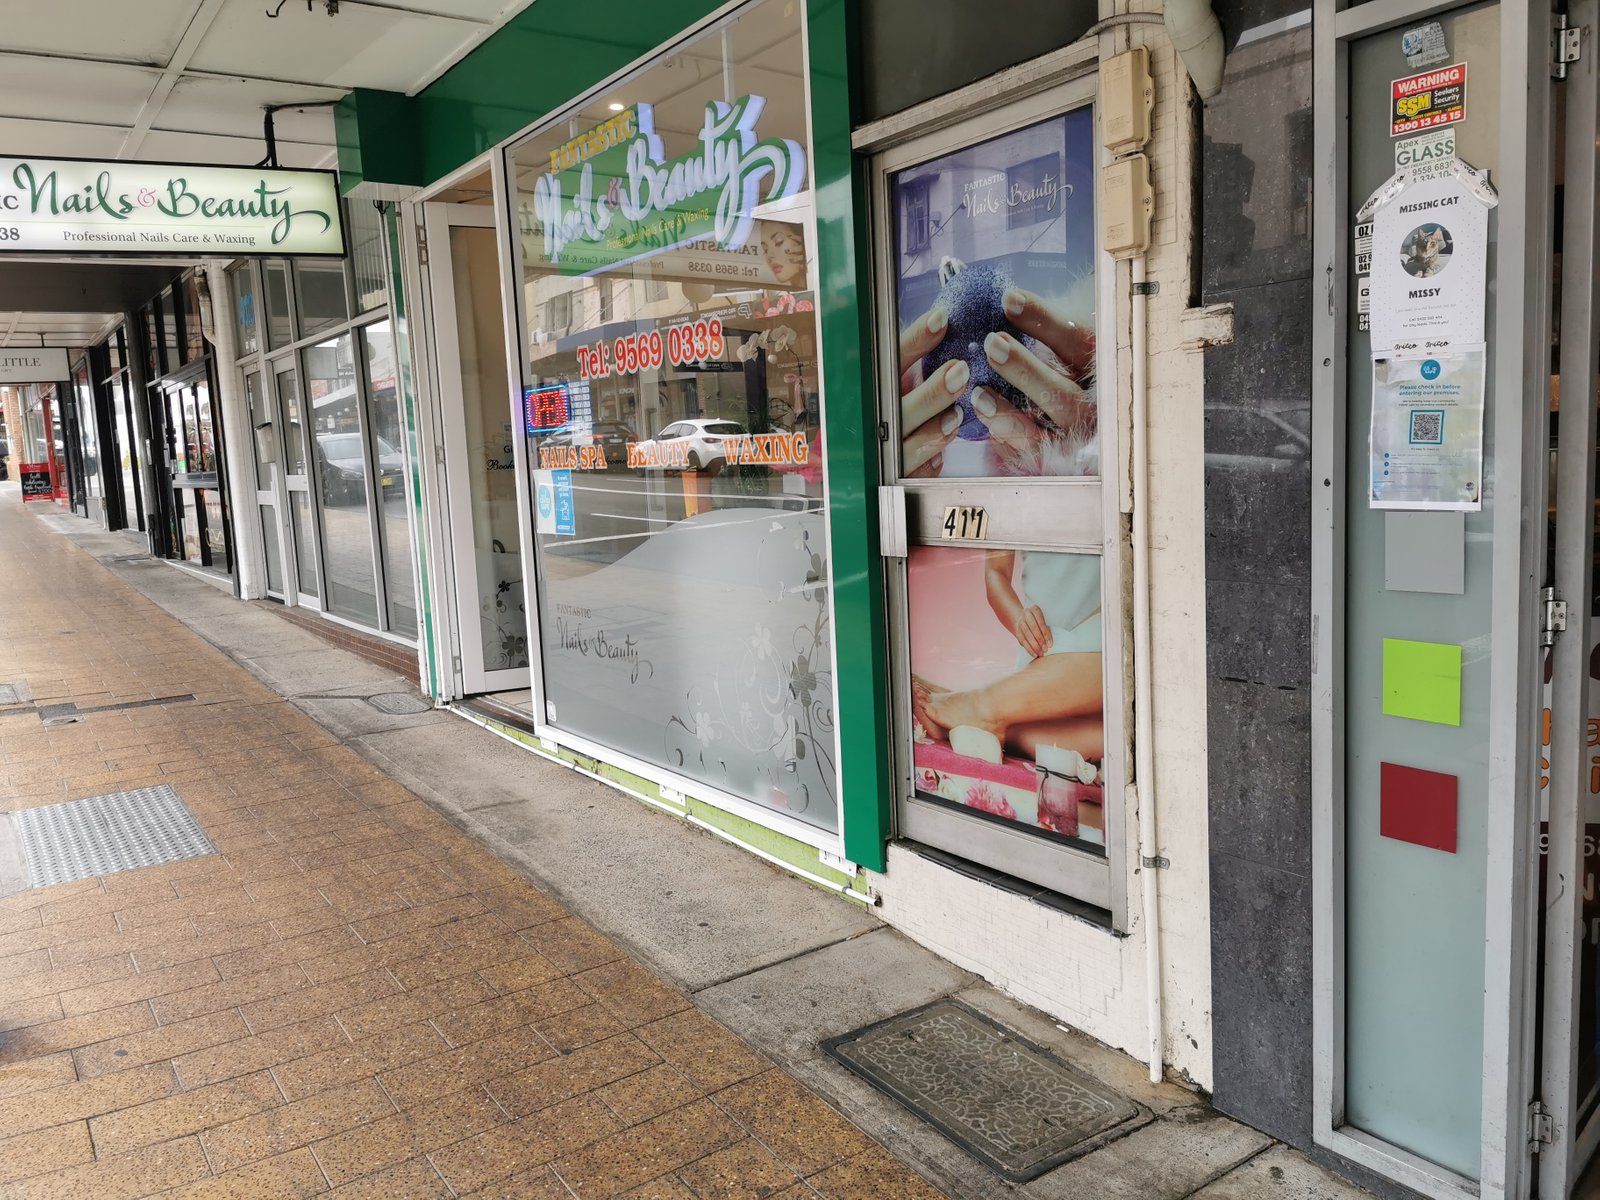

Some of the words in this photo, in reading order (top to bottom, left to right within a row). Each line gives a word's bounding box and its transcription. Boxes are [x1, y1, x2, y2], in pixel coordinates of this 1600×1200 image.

[1397, 68, 1460, 94] WARNING
[1434, 86, 1459, 98] Seekers
[1397, 93, 1431, 116] SSM
[1434, 94, 1460, 105] Security
[1394, 121, 1418, 133] 1300
[1420, 118, 1431, 127] 13
[1434, 113, 1447, 123] 45
[1450, 110, 1461, 120] 15
[550, 109, 638, 174] FANTASTIC
[1397, 138, 1419, 150] Apex
[1397, 139, 1455, 165] GLASS
[534, 162, 613, 258] Nails
[619, 104, 788, 244] Beauty
[964, 172, 1006, 192] FANTASTIC
[1412, 165, 1432, 176] 9558
[12, 162, 136, 220] Nails
[137, 187, 156, 208] &
[157, 177, 331, 245] Beauty
[963, 188, 999, 218] Nails
[1006, 173, 1073, 213] Beauty
[1400, 199, 1439, 214] MISSING
[1440, 196, 1460, 208] CAT
[63, 229, 136, 243] Professional
[140, 231, 170, 243] Nails
[172, 232, 200, 243] Care
[202, 233, 212, 242] &
[213, 233, 256, 246] Waxing
[1358, 255, 1367, 263] 02
[1408, 287, 1441, 299] MISSY
[577, 345, 610, 379] Tel:
[614, 331, 662, 375] 9569
[668, 319, 723, 366] 0338
[540, 446, 577, 470] NAILS
[580, 444, 607, 469] SPA
[626, 440, 690, 468] BEAUTY
[723, 433, 808, 465] WAXING
[556, 603, 592, 619] FANTASTIC
[556, 616, 588, 656] Nails
[594, 629, 654, 685] Beauty
